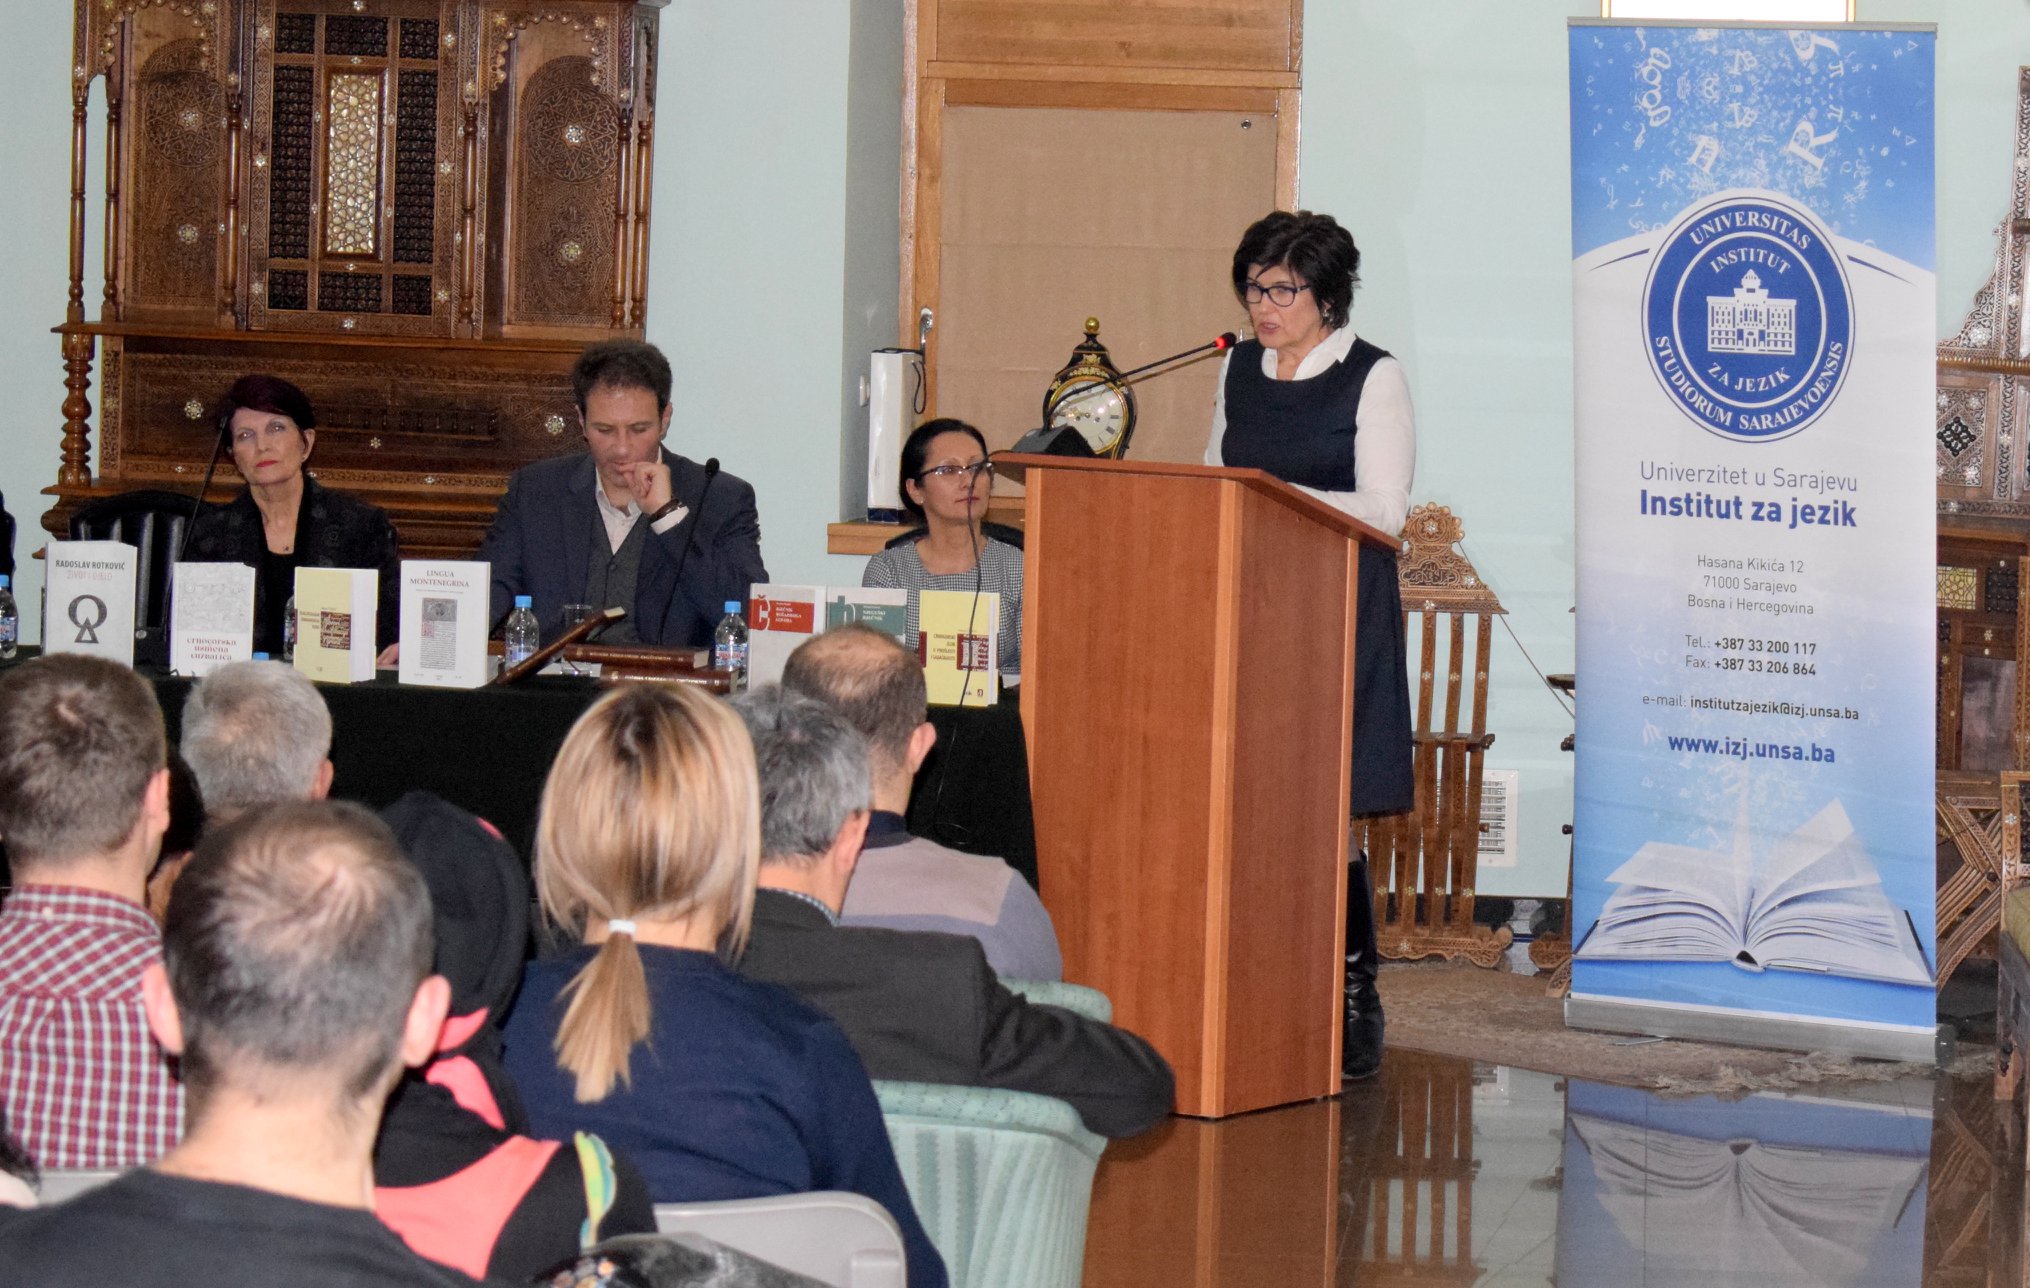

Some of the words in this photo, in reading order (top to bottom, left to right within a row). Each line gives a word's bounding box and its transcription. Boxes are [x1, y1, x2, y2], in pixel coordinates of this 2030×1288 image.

[1689, 211, 1811, 250] UNIVERSITAS
[1709, 247, 1791, 275] INSTITUT
[1655, 335, 1733, 427] STUDIORUM
[1738, 341, 1844, 431] SARAIEVOENSIS
[1707, 362, 1730, 387] ZA
[1734, 366, 1791, 392] JEZIK
[1640, 460, 1748, 486] Univerzitet
[1755, 472, 1766, 487] u
[1773, 467, 1858, 495] Sarajevu
[1640, 489, 1743, 520] Institut
[1751, 500, 1782, 523] za
[1788, 497, 1858, 530] jezik
[55, 559, 91, 569] RADOSLAV
[91, 561, 126, 571] ROTKOVIĆ
[426, 569, 455, 578] LINGUA
[1697, 554, 1743, 570] Hasana
[1747, 557, 1785, 572] Kikića
[1789, 560, 1804, 574] 12
[410, 578, 470, 588] MONTENEGRINA
[1703, 574, 1740, 590] 71000
[1743, 577, 1797, 595] Sarajevo
[1687, 594, 1726, 609] Bosna
[1736, 597, 1815, 616] Hercegovina
[1684, 634, 1711, 649] Tel.:
[1714, 637, 1745, 651] +387
[1748, 639, 1763, 652] 33
[1766, 640, 1790, 654] 200
[1793, 642, 1817, 656] 117
[1684, 654, 1711, 669] Fax:
[1714, 657, 1745, 671] +387
[1748, 659, 1763, 672] 33
[1766, 660, 1790, 674] 206
[1792, 662, 1817, 676] 864
[1642, 694, 1687, 708] e-mail:
[1689, 694, 1860, 721] institutzajezik@izj.unsa.ba
[1667, 735, 1836, 764] www.izj.unsa.ba
